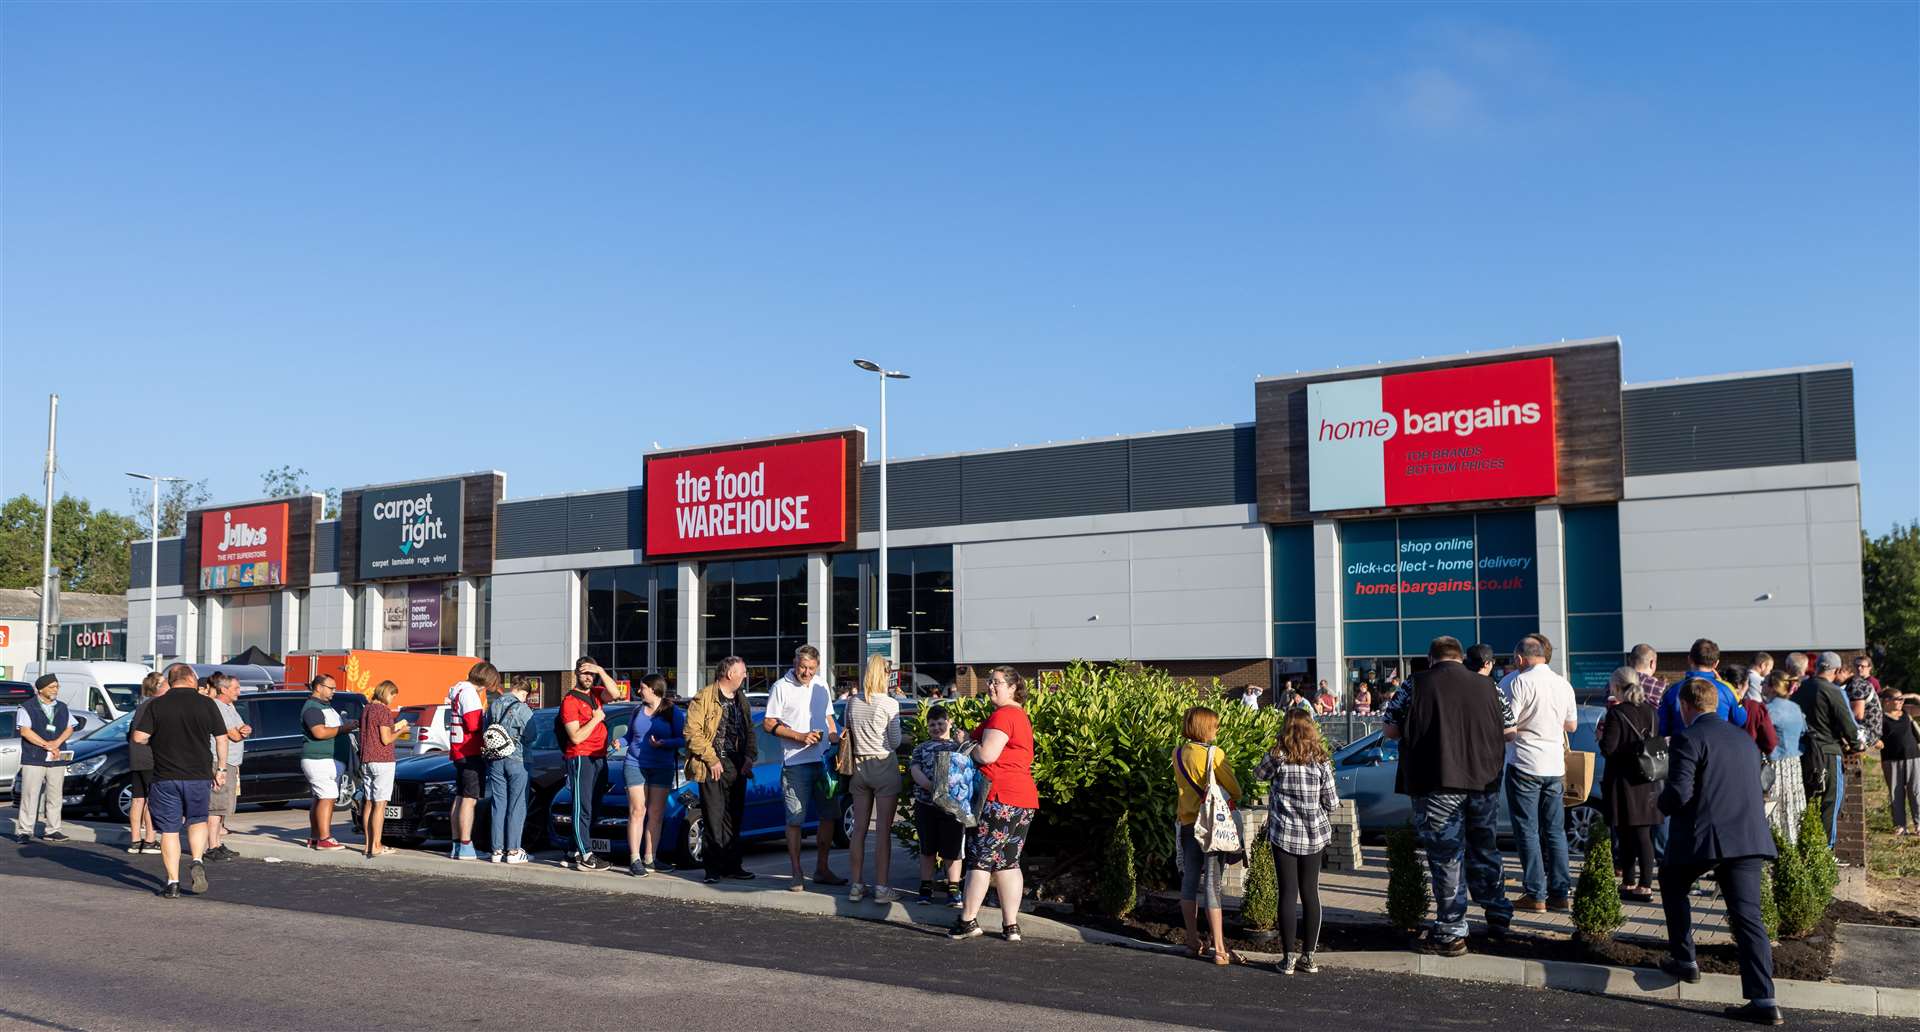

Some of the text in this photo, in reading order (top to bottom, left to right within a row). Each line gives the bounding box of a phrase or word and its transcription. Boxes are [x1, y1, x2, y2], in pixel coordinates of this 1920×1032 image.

[1318, 400, 1541, 441] home bargains
[1407, 447, 1482, 460] TOP BRANDS
[1407, 458, 1504, 475] BOTTOM PRICES
[676, 462, 764, 503] the food
[373, 493, 432, 524] carpet
[676, 496, 809, 539] WAREHOUSE
[1401, 538, 1474, 554] shop online
[372, 554, 447, 568] carpet laminate rugs vinyl
[1437, 559, 1474, 571] home
[1479, 556, 1531, 570] delivery
[412, 613, 430, 621] beaten
[76, 629, 112, 647] COSTA
